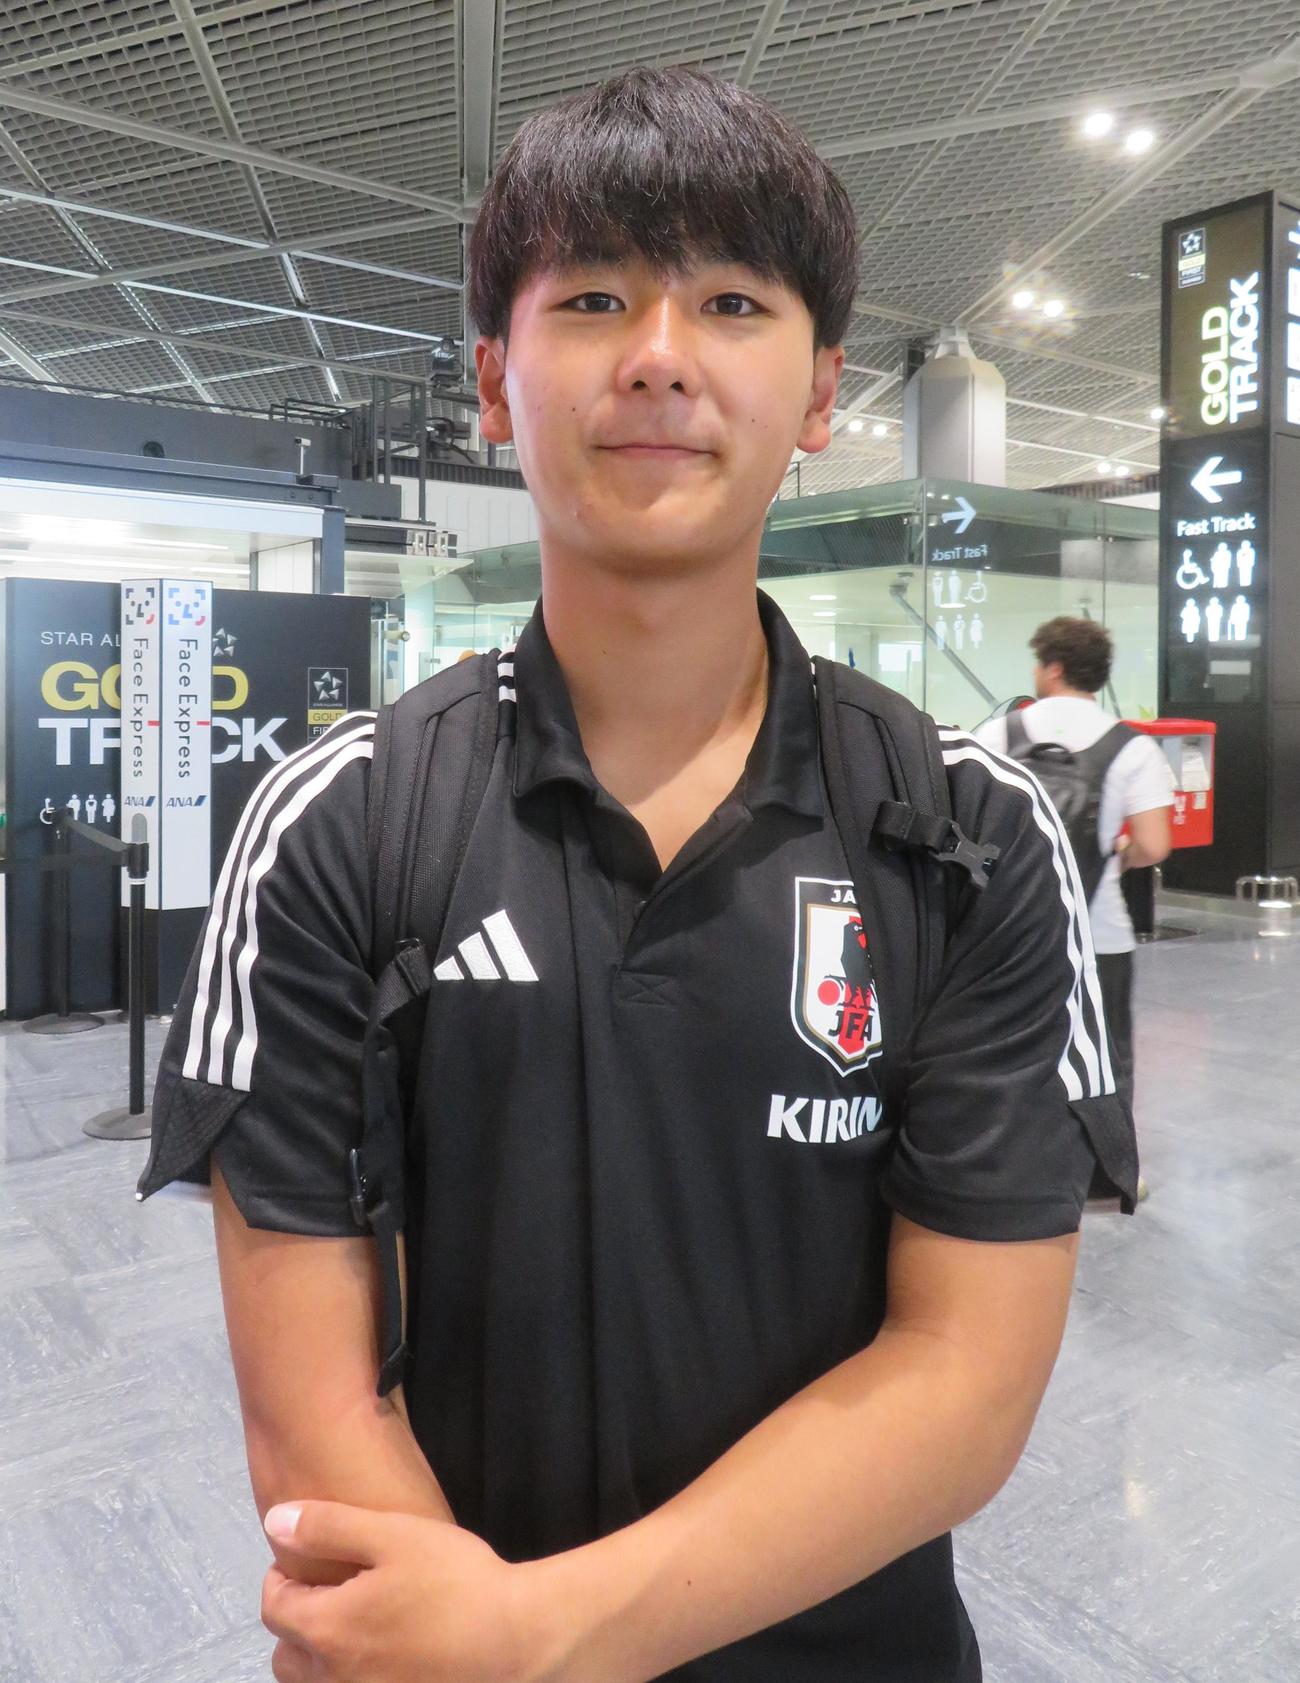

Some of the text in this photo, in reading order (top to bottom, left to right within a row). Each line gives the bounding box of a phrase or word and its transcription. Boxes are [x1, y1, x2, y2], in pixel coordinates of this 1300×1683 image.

[1200, 306, 1229, 426] GOLD
[1229, 271, 1259, 424] TRACK
[1176, 512, 1256, 537] Fast Track
[40, 631, 93, 646] STAR
[41, 661, 249, 711] GD
[130, 637, 149, 778] Face Express
[174, 638, 198, 779] Face Express
[38, 716, 288, 766] TRCK
[166, 796, 193, 808] ANA
[827, 1010, 874, 1042] JFA
[766, 1094, 883, 1144] KIRIN
